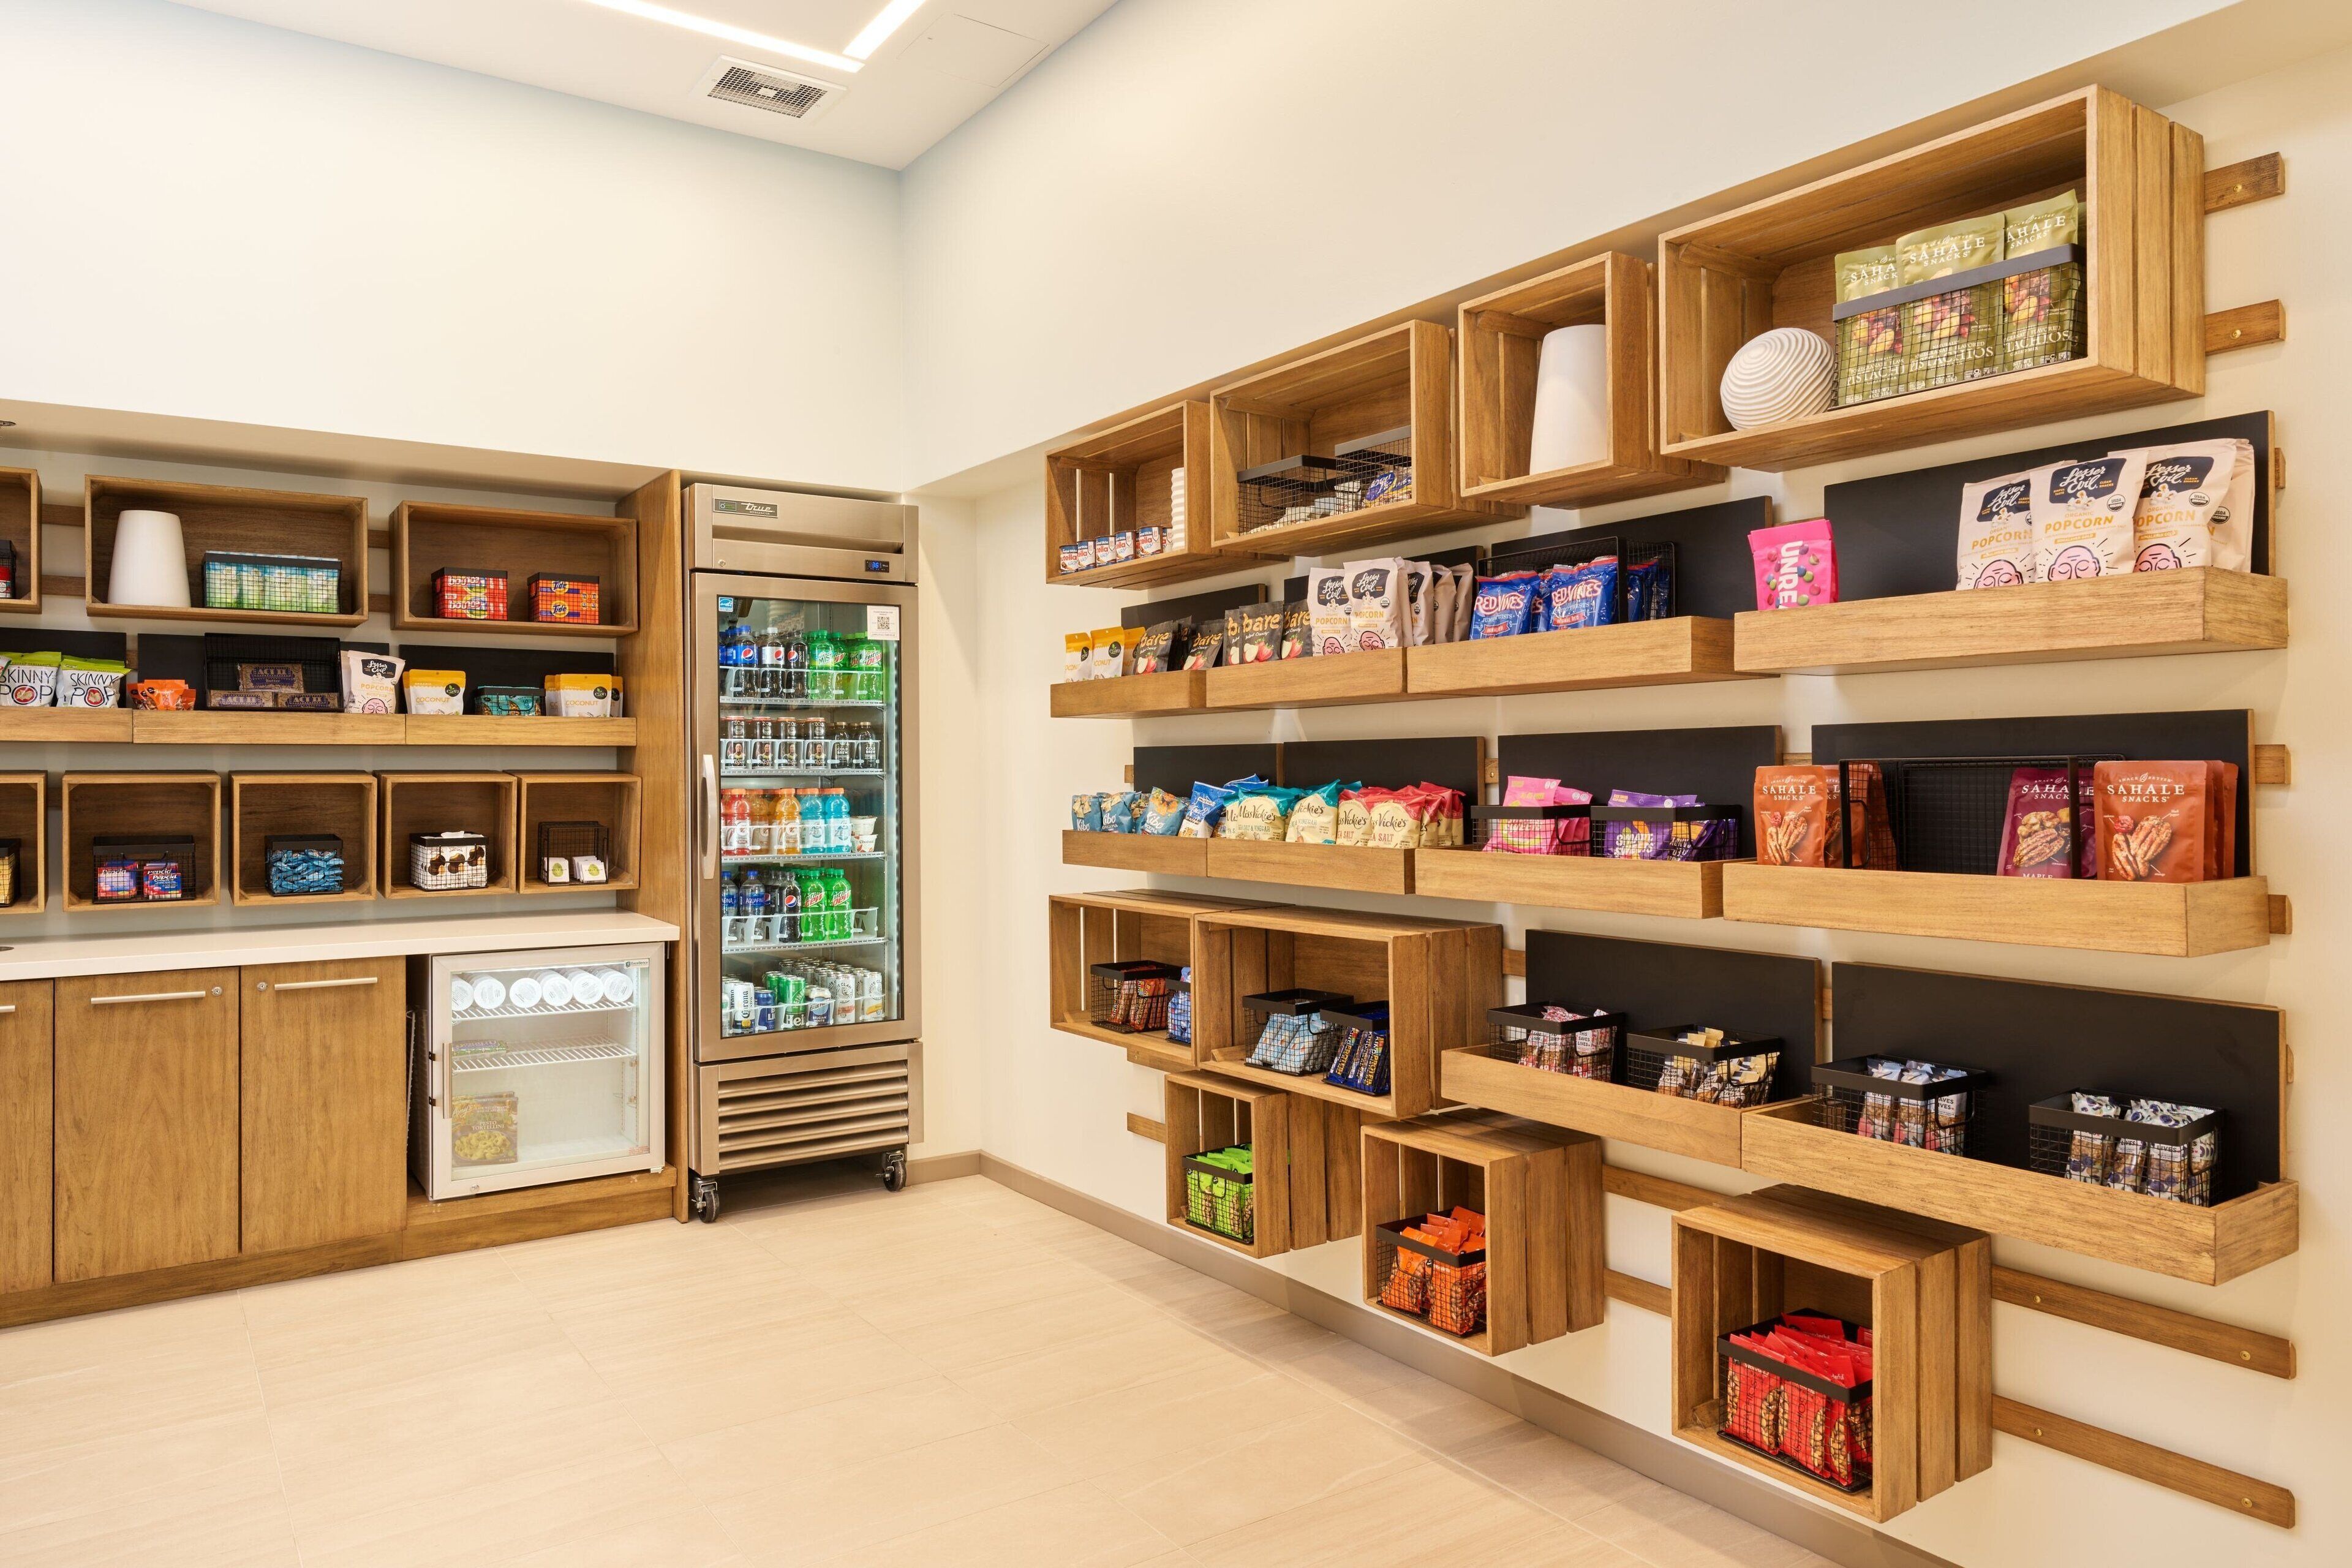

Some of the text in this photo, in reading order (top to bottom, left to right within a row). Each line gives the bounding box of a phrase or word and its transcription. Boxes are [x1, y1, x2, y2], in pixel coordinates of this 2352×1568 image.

[2006, 216, 2066, 243] AHALE
[2010, 230, 2048, 249] SNACKS
[1910, 236, 1985, 263] SAHALE
[1923, 251, 1969, 267] SNACKS
[1850, 263, 1896, 283] SAHA
[1864, 271, 1898, 285] SNACK
[1909, 346, 1994, 372] PISTACHIOS
[1846, 364, 1905, 386] PISTACHI
[2060, 466, 2106, 488] Lesser
[2145, 463, 2192, 480] Lesser
[741, 502, 774, 513] true
[2147, 505, 2175, 513] ORGANIC
[2045, 515, 2114, 534] POPCORN
[2134, 510, 2196, 528] OPCORN
[1971, 529, 2033, 550] POPCORN
[448, 576, 480, 586] bounce
[1357, 573, 1380, 587] Lesser
[1778, 540, 1803, 609] UNRE
[553, 581, 567, 589] Tide
[1322, 579, 1344, 593] Lesser
[1568, 579, 1602, 601] VINES
[449, 599, 481, 610] bounce
[553, 605, 567, 614] Tide
[1474, 596, 1499, 616] RED
[1498, 592, 1525, 611] VINES
[1243, 613, 1281, 633] bare
[1140, 631, 1169, 649] bare
[1193, 632, 1222, 647] bare
[367, 660, 388, 669] Lesser
[70, 671, 119, 687] SKINNY
[0, 684, 53, 704] POP
[361, 683, 394, 693] POPCORN
[70, 687, 115, 707] POP
[1762, 785, 1816, 795] SAHALE
[2021, 784, 2069, 794] SAHA
[2107, 784, 2185, 795] SAHALE
[1147, 811, 1166, 829] Kibo
[1238, 804, 1276, 821] Miss Vickie's
[1344, 809, 1367, 826] Vickie's
[1379, 810, 1407, 829] Vickie's
[1077, 818, 1090, 831] Kibo
[1343, 831, 1354, 839] SALT
[1378, 833, 1394, 842] SALT
[1616, 833, 1653, 846] SMART
[1614, 843, 1654, 858] SWEETS
[741, 990, 750, 1018] Corona
